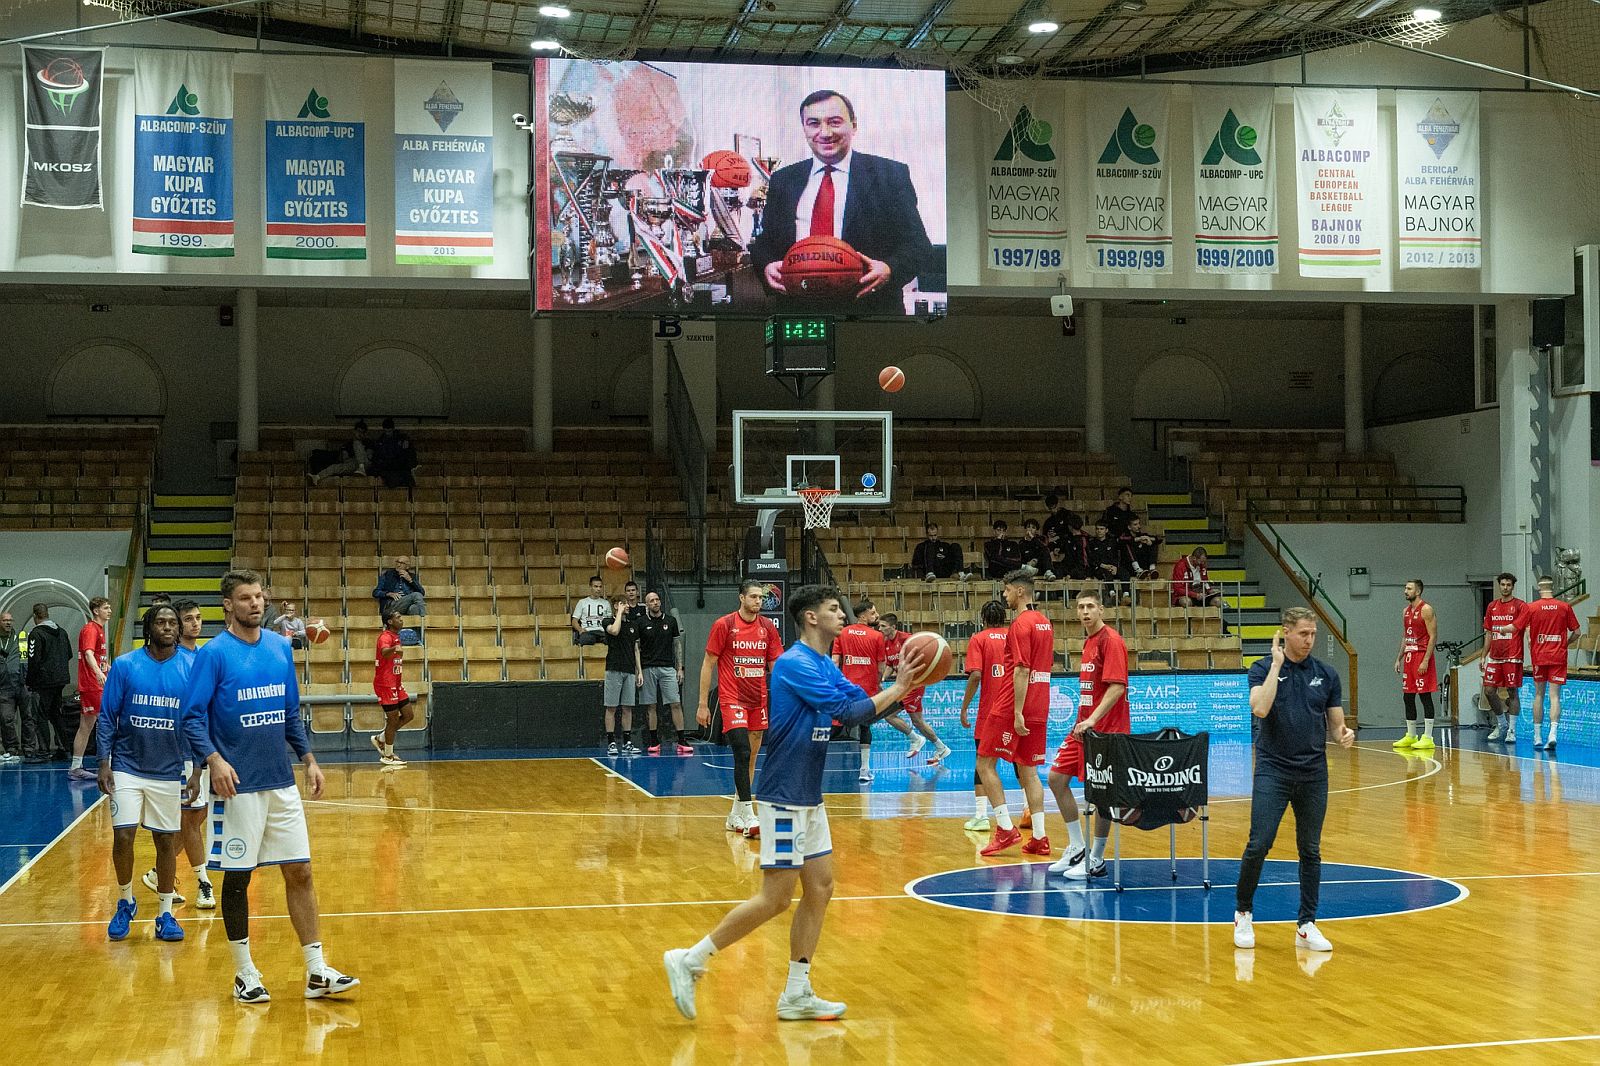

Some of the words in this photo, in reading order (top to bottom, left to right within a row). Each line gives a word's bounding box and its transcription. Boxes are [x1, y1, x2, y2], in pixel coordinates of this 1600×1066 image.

[140, 120, 227, 136] ALBACOMP-SZÜV
[275, 125, 354, 138] ALBACOMP-UPC
[402, 139, 430, 152] ALBA
[432, 138, 486, 153] FEHÉRVÁR
[1301, 149, 1371, 163] ALBACOMP
[34, 161, 92, 173] MKOSZ
[153, 155, 215, 174] MAGYAR
[285, 159, 346, 177] MAGYAR
[990, 166, 1057, 178] ALBACOMP-SZÜV
[1421, 165, 1458, 174] BERICAP
[412, 168, 476, 184] MAGYAR
[1096, 168, 1162, 180] ALBACOMP-SZÜV
[1200, 169, 1242, 179] ALBACOMP
[1248, 170, 1264, 180] UPC
[1318, 168, 1356, 178] CENTRAL
[1404, 176, 1428, 186] ALBA
[1430, 175, 1474, 186] FEHÉRVÁR
[164, 176, 204, 193] KUPA
[297, 179, 336, 196] KUPA
[1314, 180, 1359, 190] EUROPEAN
[424, 188, 465, 204] KUPA
[988, 184, 1060, 202] MAGYAR
[1310, 192, 1364, 202] BASKETBALL
[150, 194, 218, 216] GYŐZTES
[284, 198, 348, 218] GYŐZTES
[1096, 194, 1165, 212] MAGYAR
[1198, 195, 1268, 212] MAGYAR
[1320, 203, 1354, 212] LEAGUE
[1404, 194, 1476, 211] MAGYAR
[409, 207, 480, 225] GYŐZTES
[990, 205, 1059, 222] BAJNOK
[1098, 214, 1164, 232] BAJNOK
[1202, 215, 1266, 232] BAJNOK
[1311, 218, 1363, 232] BAJNOK
[1404, 216, 1476, 232] BAJNOK
[1314, 234, 1340, 244] 2008
[1348, 234, 1361, 244] 09
[433, 246, 456, 256] 2013
[787, 252, 846, 266] SPALDING
[993, 248, 1062, 270] 1997/98
[1097, 248, 1166, 270] 1998/99
[1196, 248, 1275, 269] 1999/2000
[1406, 252, 1434, 264] 2012
[1448, 252, 1476, 264] 2013
[732, 640, 768, 650] HONVÉD
[1156, 701, 1198, 712] Központ
[1086, 761, 1114, 785] SPALDING
[1128, 764, 1202, 787] SPALDING
